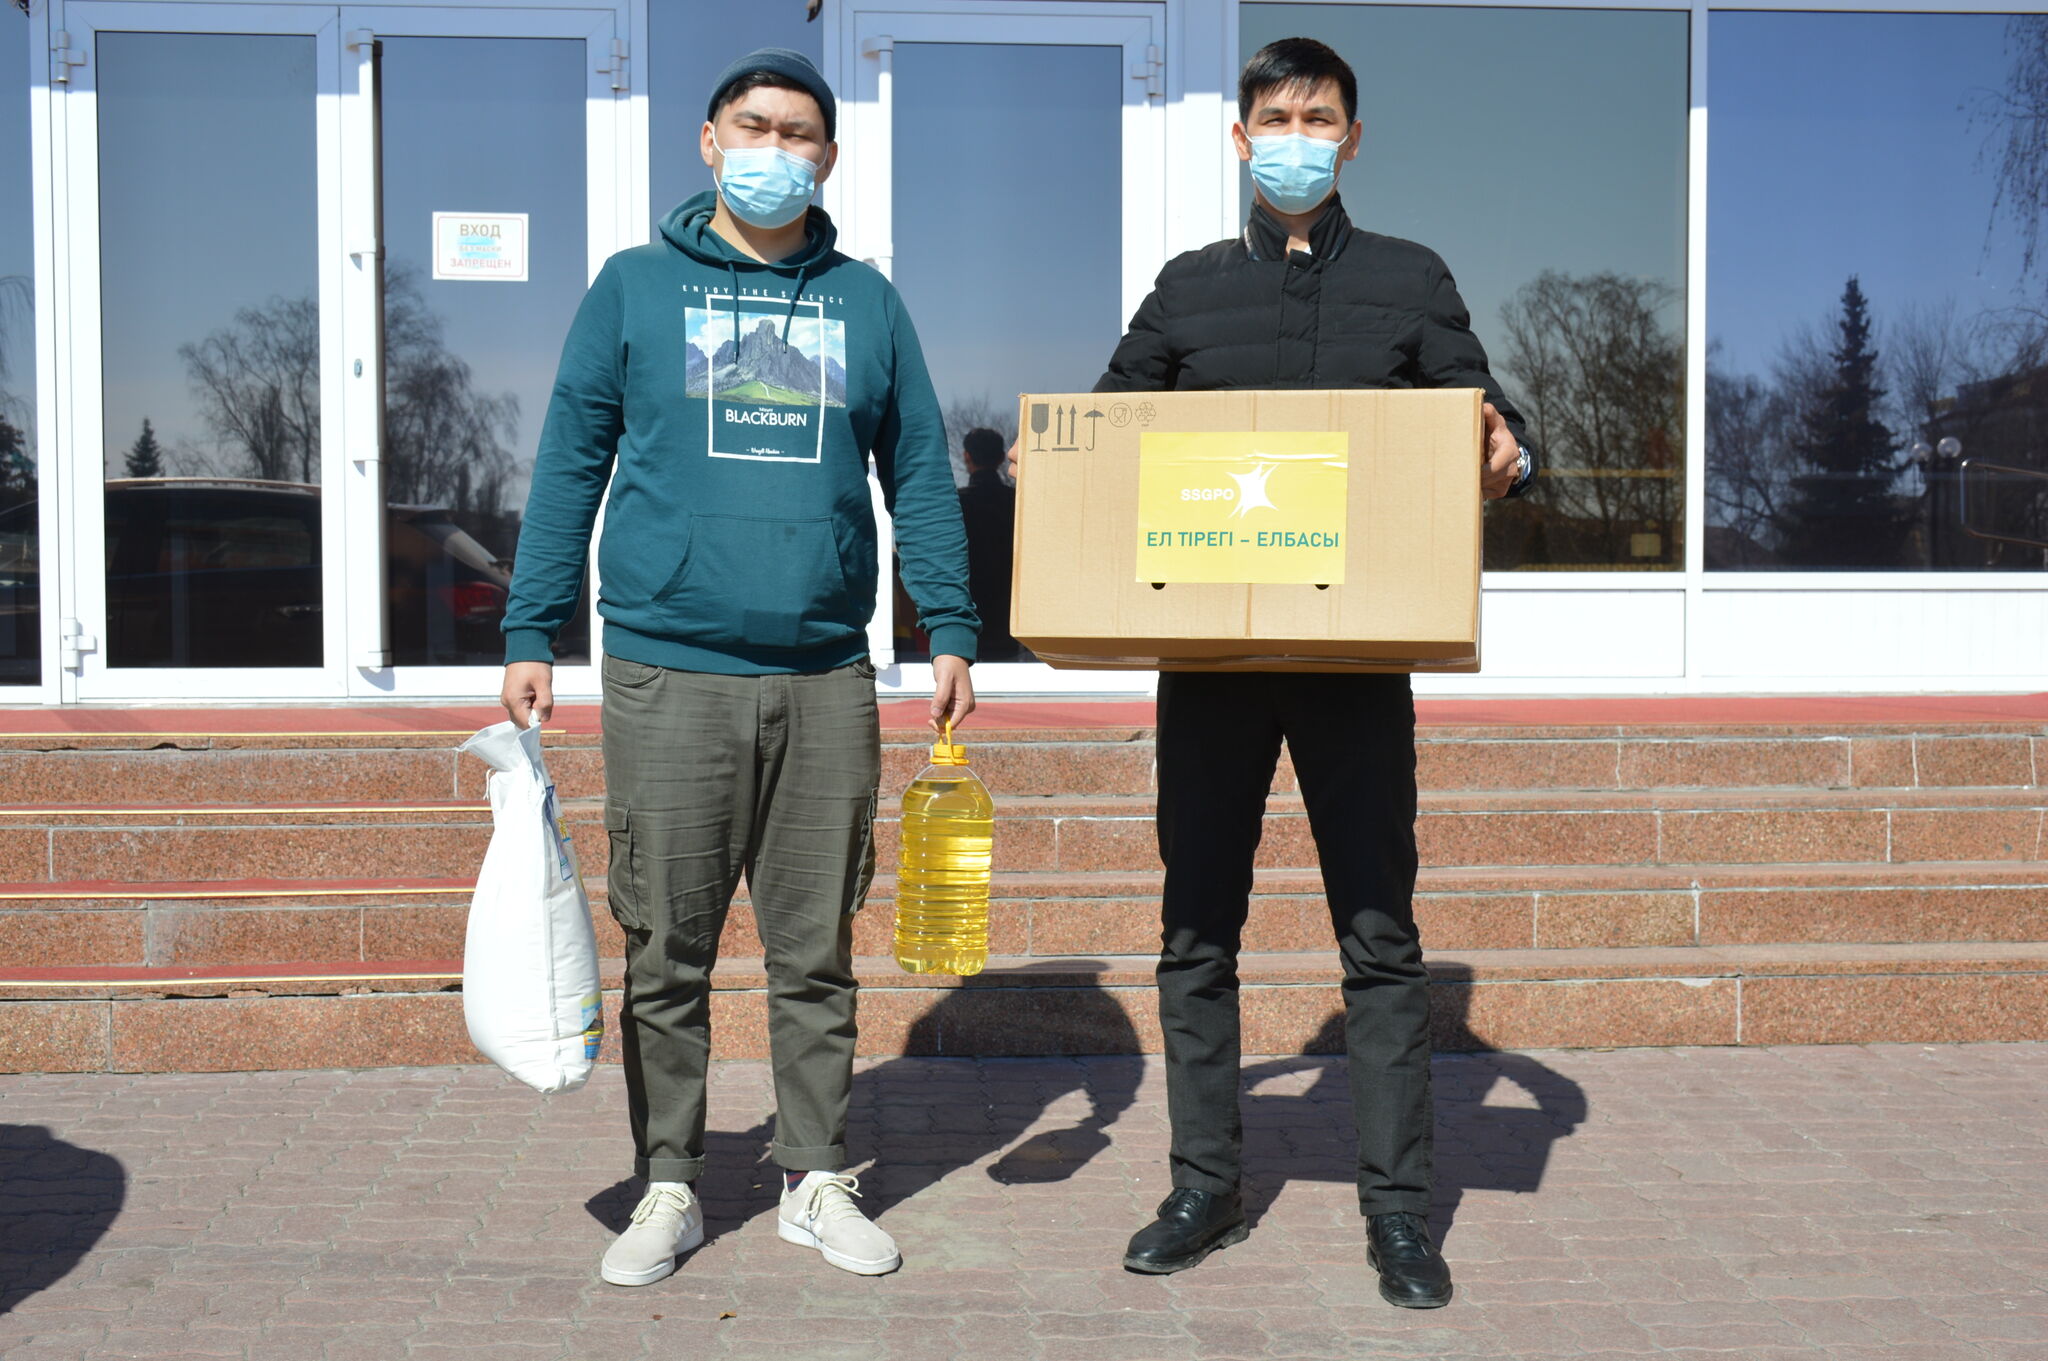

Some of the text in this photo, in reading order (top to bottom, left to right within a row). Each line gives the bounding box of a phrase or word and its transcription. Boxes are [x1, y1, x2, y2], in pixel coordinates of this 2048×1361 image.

[460, 224, 502, 239] ВХОД
[450, 258, 512, 269] ЗАПРЕЩЕН
[682, 284, 729, 295] ENJOY
[742, 287, 768, 297] THE
[725, 408, 807, 426] BLACKBURN
[1181, 488, 1235, 501] SSGPO
[1147, 531, 1172, 547] ЕЛ
[1178, 531, 1233, 547] ТІРЕГІ
[1257, 531, 1339, 548] ЕЛБАСЫ
